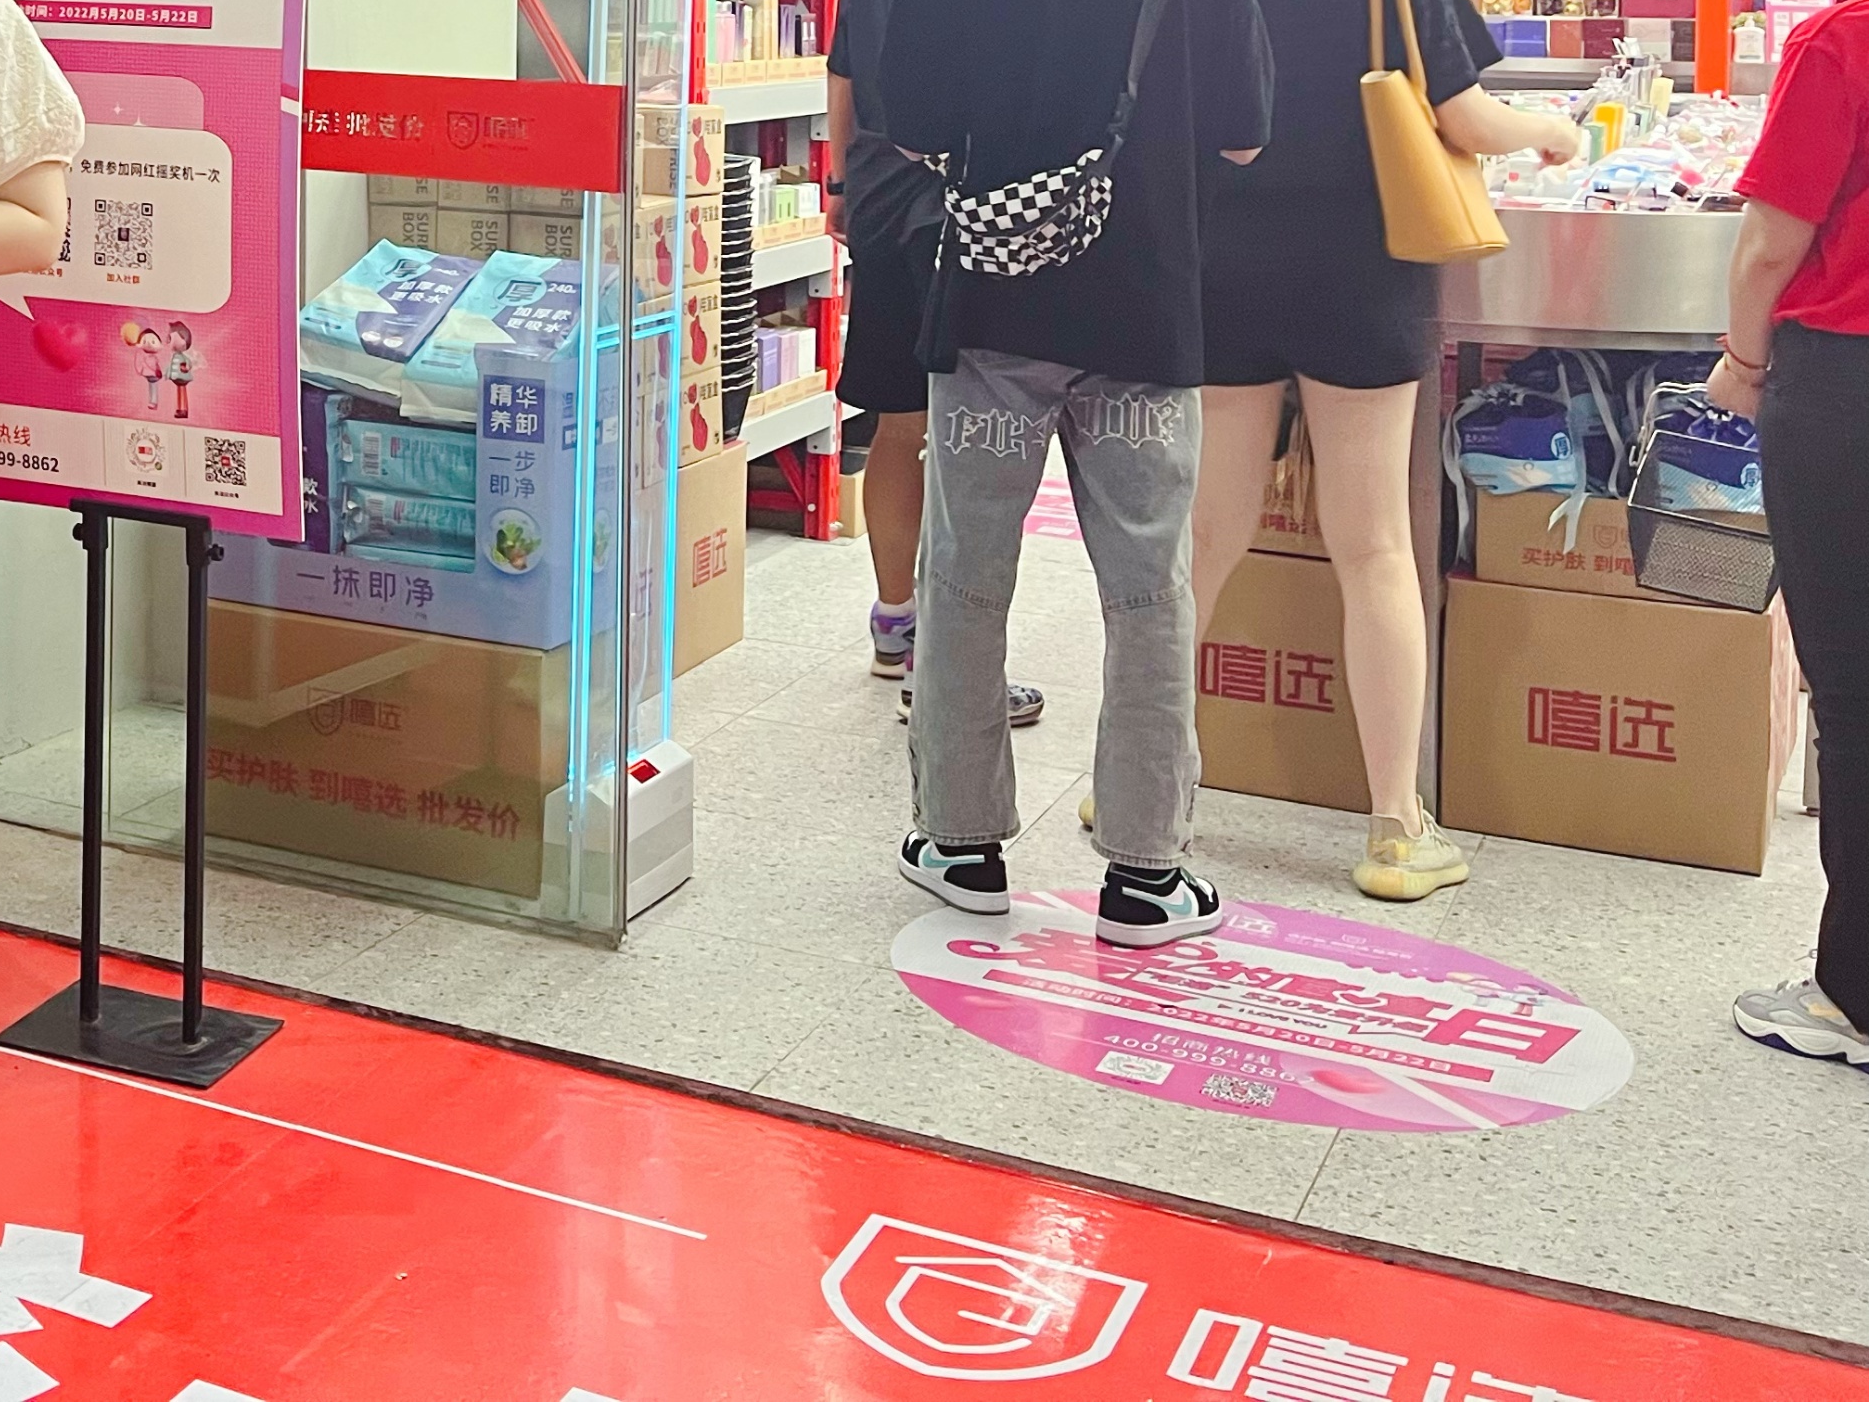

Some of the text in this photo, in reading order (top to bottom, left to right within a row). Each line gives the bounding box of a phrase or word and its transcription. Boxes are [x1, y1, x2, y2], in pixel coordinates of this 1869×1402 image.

[80, 159, 221, 184] 免费参加网红摇奖机一次
[402, 212, 414, 243] BOX
[470, 220, 483, 252] BOX
[501, 280, 543, 303] 厚
[507, 319, 563, 333] 更吸水
[516, 306, 572, 321] 加厚款
[490, 383, 538, 409] 精华
[490, 410, 539, 437] 养卸
[489, 451, 536, 473] 一步
[489, 475, 536, 498] 即净
[1521, 549, 1586, 570] 买护肤
[297, 565, 434, 607] 一抹即净
[1200, 641, 1334, 713] 嘻选
[1528, 685, 1677, 763] 嘻选
[207, 747, 521, 842] 买护肤 到嘻选 批发价
